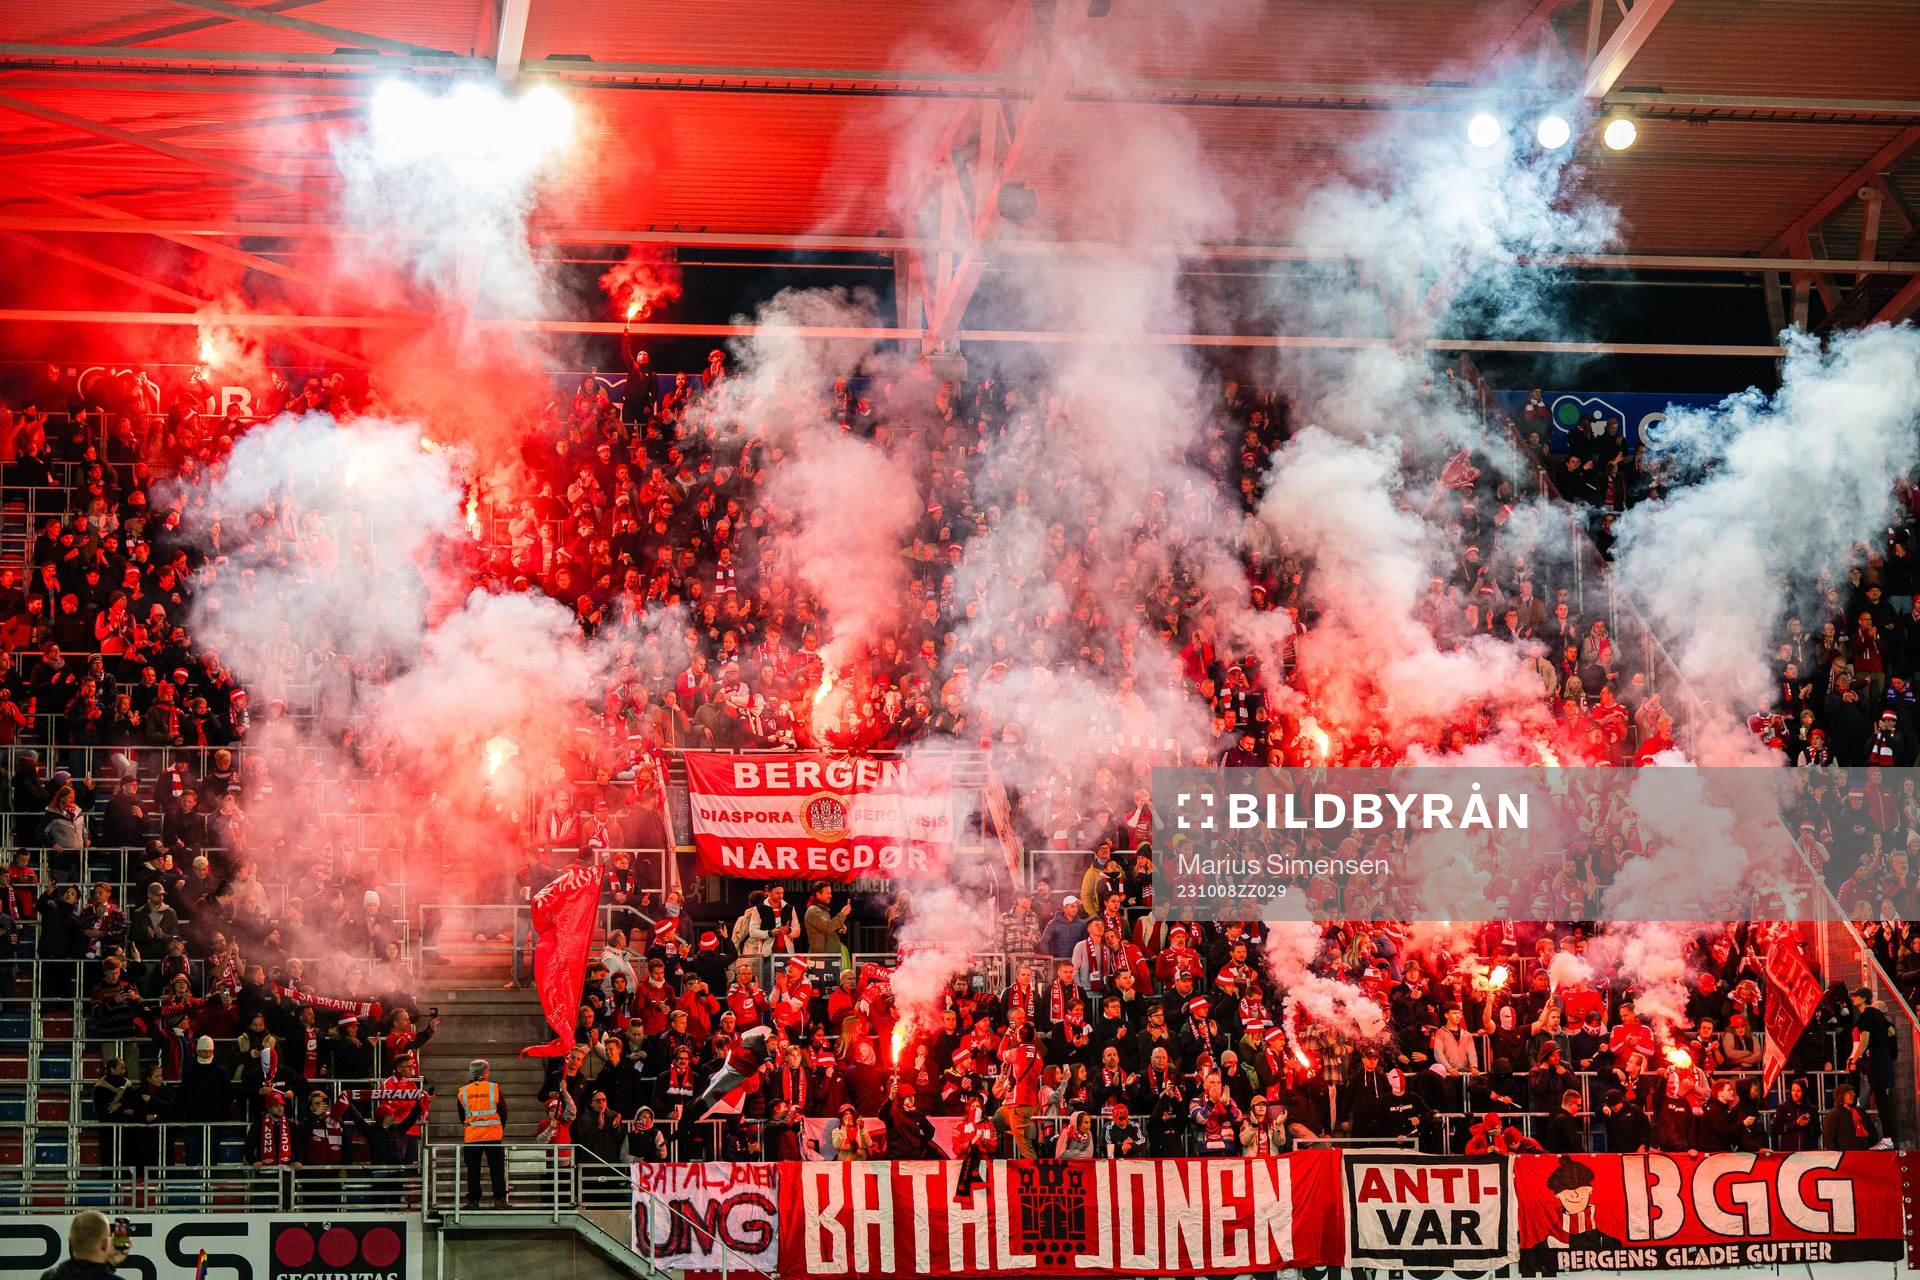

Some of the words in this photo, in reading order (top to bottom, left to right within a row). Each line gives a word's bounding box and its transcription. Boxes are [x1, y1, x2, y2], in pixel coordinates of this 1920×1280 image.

[732, 760, 908, 789] BERGEN
[700, 809, 794, 824] DIASPORA
[854, 808, 948, 828] BERGSIS
[721, 842, 800, 871] NÅR
[299, 991, 314, 1003] SK
[316, 996, 358, 1012] BRANN
[263, 1126, 272, 1153] 2022
[1357, 1167, 1498, 1204] ANTI-
[1621, 1151, 1857, 1241] BGG
[635, 1192, 777, 1258] UNG
[1377, 1209, 1481, 1246] VAR
[1557, 1248, 1658, 1271] BERGENS
[1665, 1245, 1740, 1267] GLADE
[1747, 1241, 1832, 1263] GUTTER
